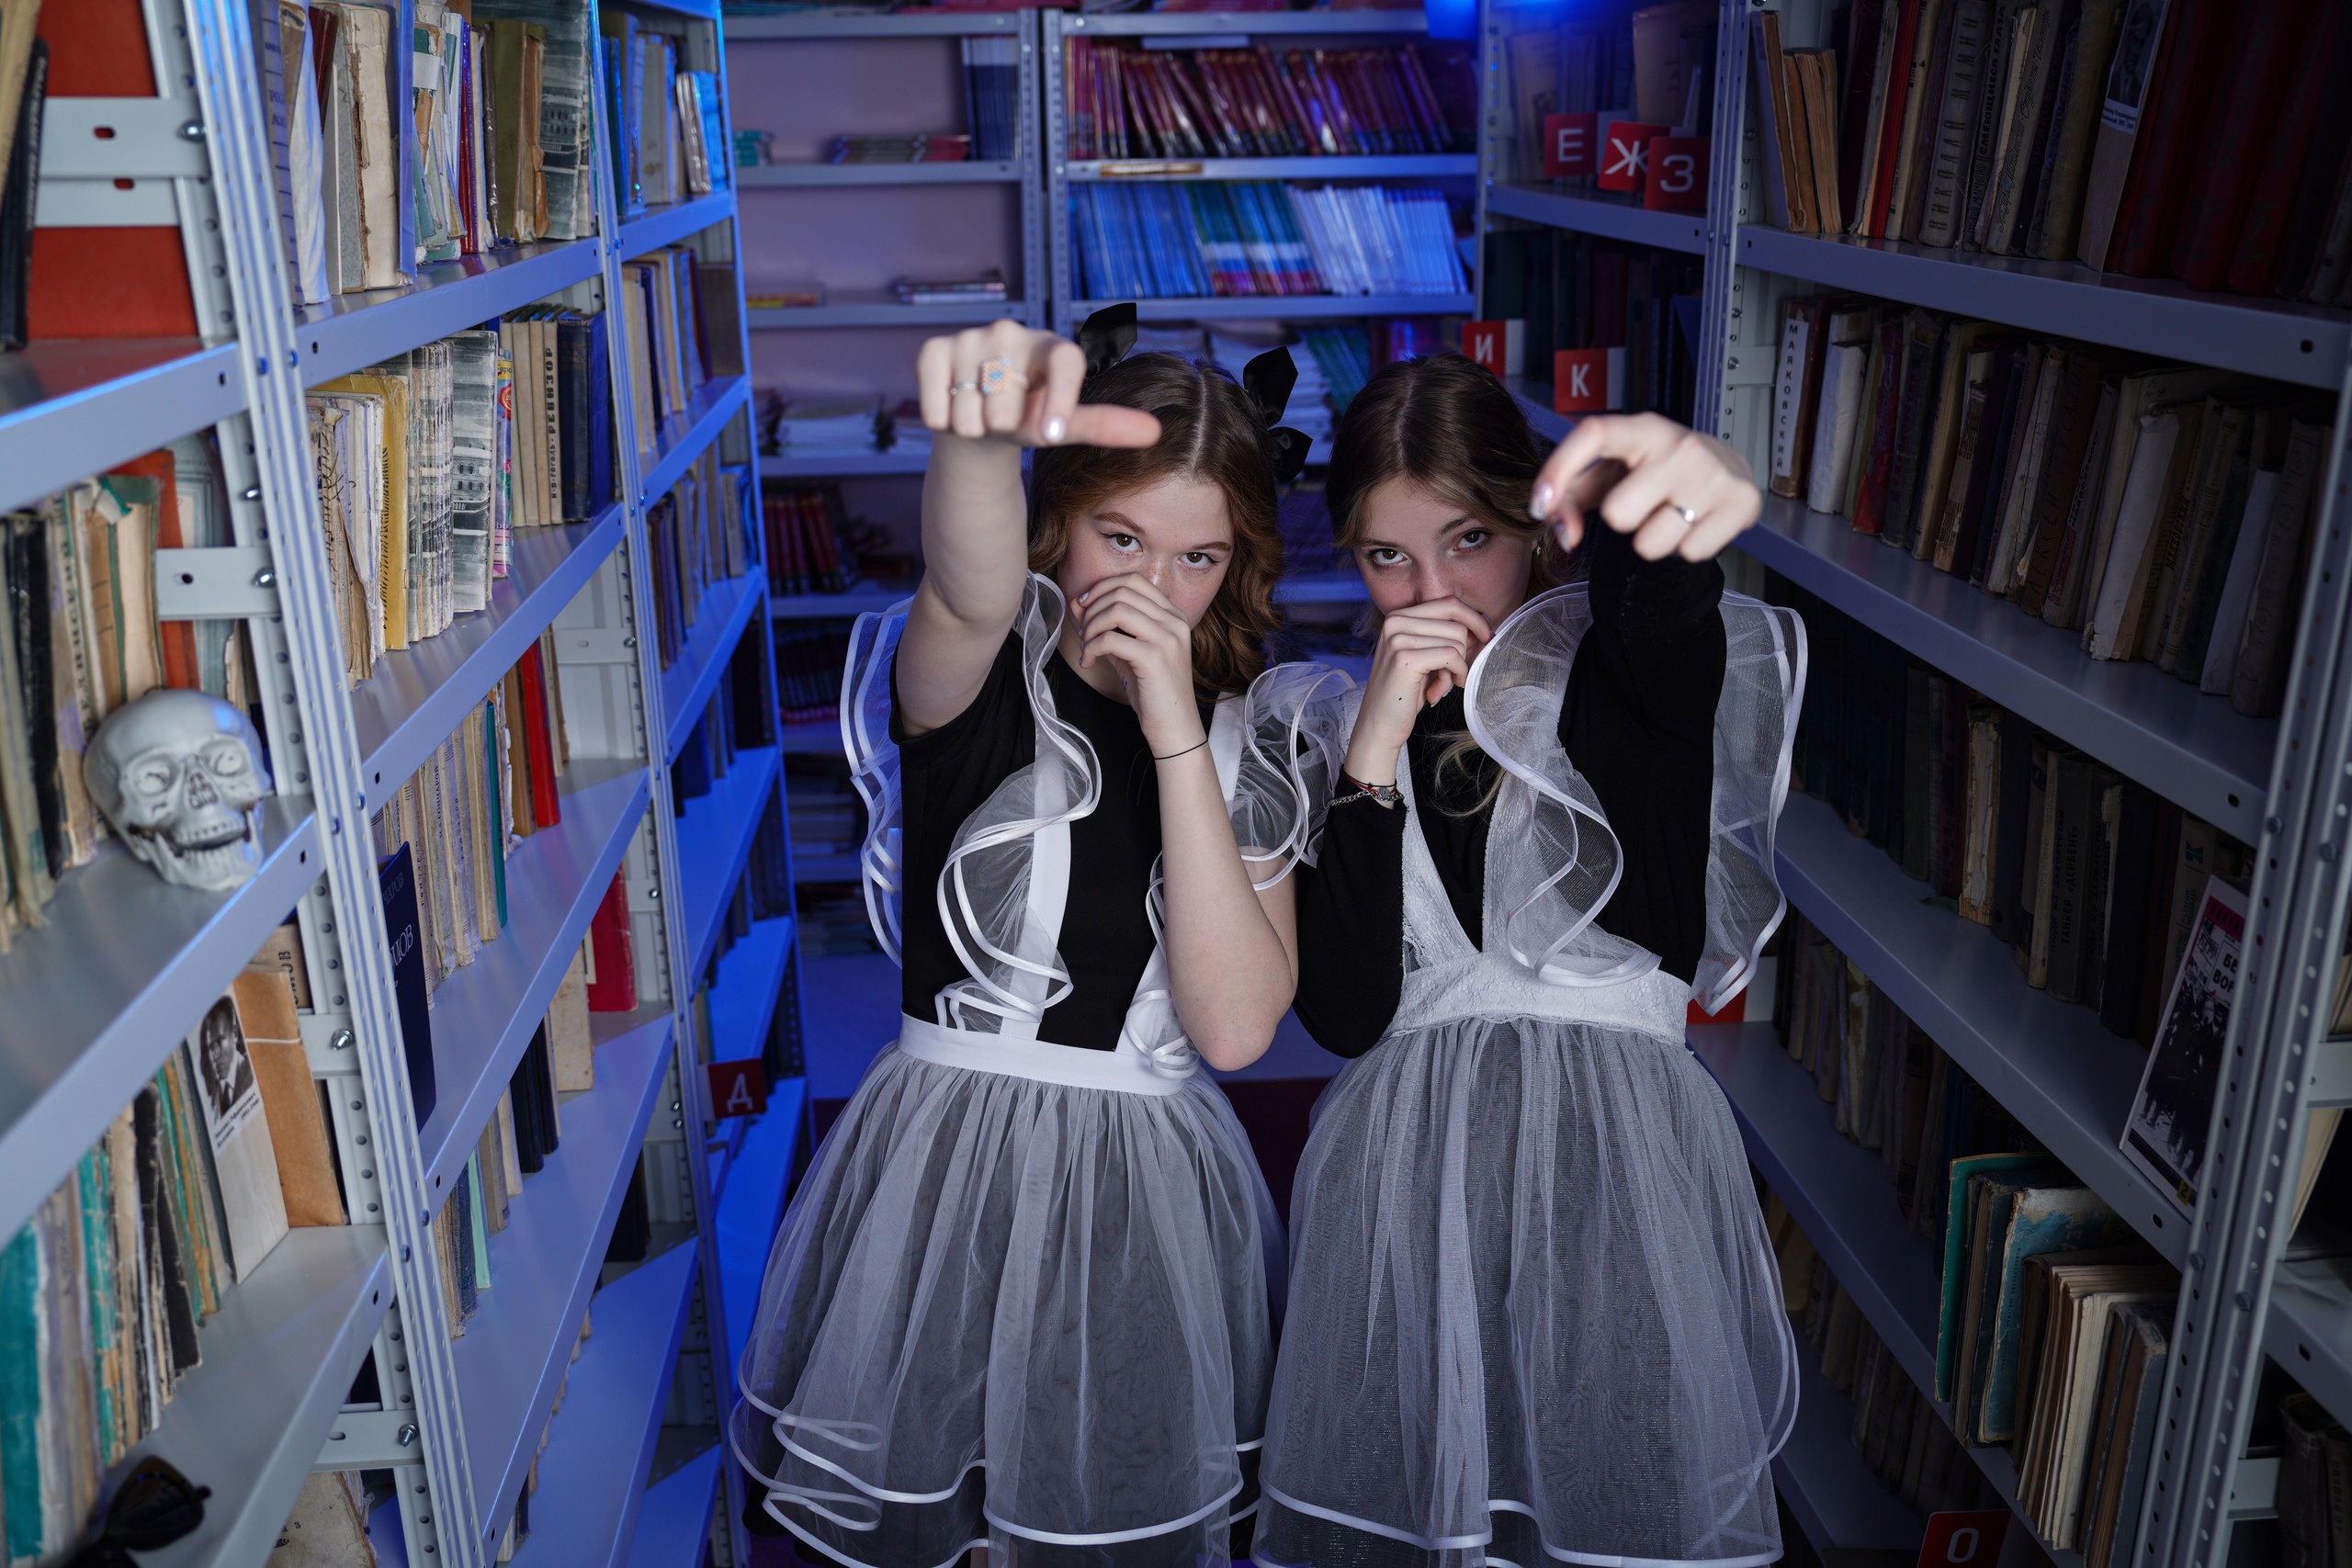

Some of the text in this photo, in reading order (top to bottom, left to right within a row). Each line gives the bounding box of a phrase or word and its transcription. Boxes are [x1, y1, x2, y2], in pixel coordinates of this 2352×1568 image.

[1979, 6, 2007, 155] СМЕЮЩИЕСЯ ГЛАЗА
[2019, 68, 2041, 119] Студенты
[2034, 6, 2054, 64] Инженеры
[1557, 128, 1584, 163] Е
[1604, 137, 1649, 177] Ж
[1928, 17, 1979, 231] НИКОЛАЙ МАМИН
[1659, 154, 1696, 193] З
[1968, 163, 1984, 248] АНАТОЛИЙ МАРЧЕНКО
[1475, 333, 1495, 364] И
[1570, 363, 1591, 399] К
[545, 347, 556, 434] РЕВИЗОР
[1776, 324, 1799, 468] МАЯКОВСКИЙ
[1894, 371, 1917, 479] МАЯКОВСКИЙ
[1995, 479, 2008, 528] МАЯКОВСКИЙ
[2007, 424, 2019, 471] СОВЕТСКАЯ
[2069, 429, 2099, 529] МАЯКОВСКОГО
[2164, 493, 2191, 571] МАЯКОВСКИЙ
[414, 840, 424, 907] ГОНЧАРОВ
[2054, 809, 2065, 889] ЗАХОЛУСТЬЯ
[2061, 825, 2079, 946] ТАНКЕР «ДЕРБЕНТ»
[2086, 926, 2097, 964] ЛЮДИ
[2093, 820, 2103, 900] ЗАХОЛУСТЬЯ
[2186, 888, 2197, 926] МЕДВЕДЕВ
[2212, 968, 2235, 993] ВОР
[2222, 952, 2239, 974] БЕ
[726, 1072, 753, 1113] Д
